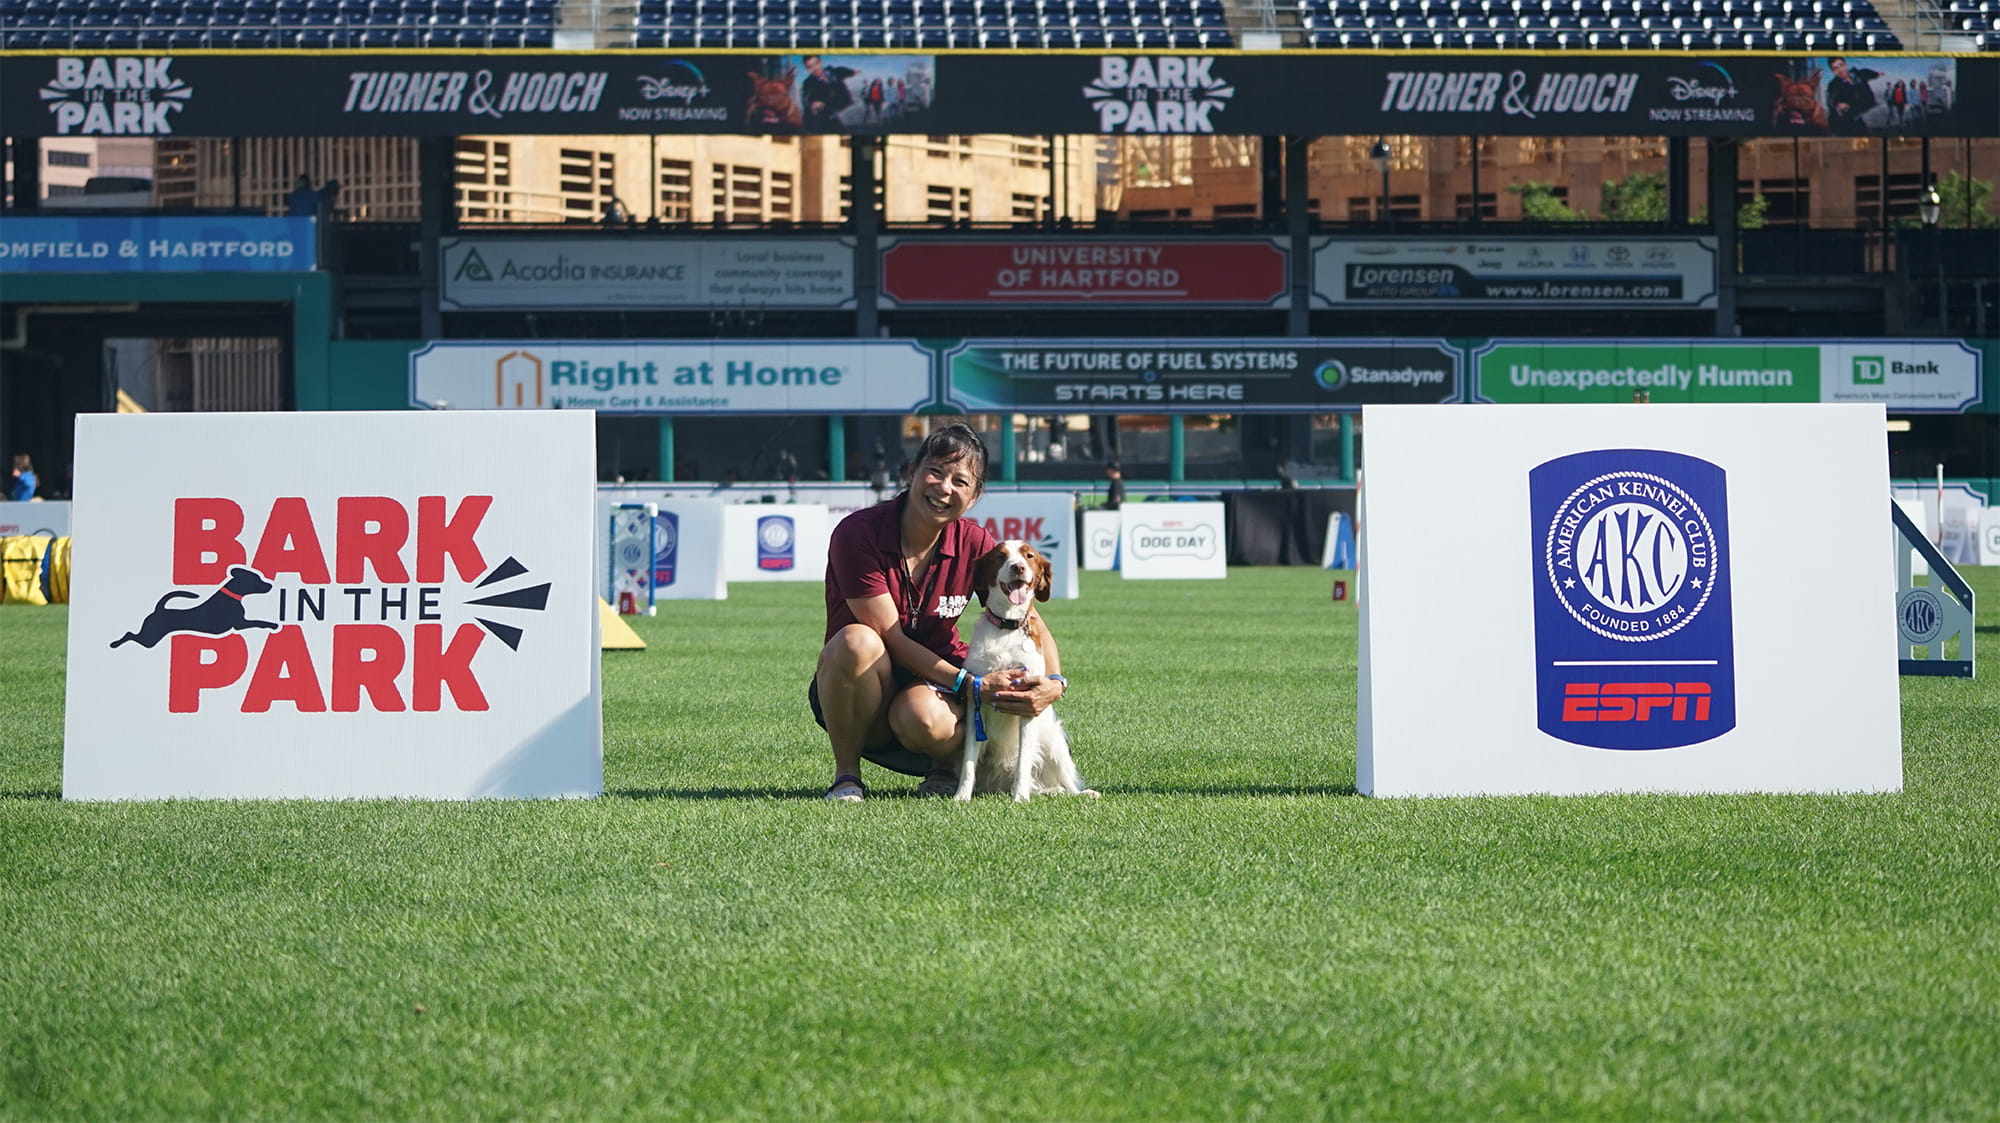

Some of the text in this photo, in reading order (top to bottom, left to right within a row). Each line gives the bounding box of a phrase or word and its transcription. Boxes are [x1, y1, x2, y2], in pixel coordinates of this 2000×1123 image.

[57, 57, 173, 89] BARK
[1101, 56, 1214, 88] BARK
[84, 90, 151, 100] IN THE
[344, 69, 608, 118] TURNER & HOOCH
[1127, 88, 1194, 100] IN THE
[1381, 70, 1638, 118] TURNER & HOOCH
[57, 101, 172, 134] PARK
[619, 108, 727, 120] NOW STREAMING
[1101, 101, 1214, 133] PARK
[1650, 109, 1754, 121] NOW STREAMING
[118, 240, 138, 257] &
[150, 240, 293, 258] HARTFORD
[737, 251, 824, 262] Local business
[1013, 247, 1162, 265] UNIVERSITY
[501, 255, 684, 280] Acadia INSURANCE
[714, 268, 842, 281] community coverage
[997, 269, 1179, 287] OF HARTFORD
[1353, 266, 1454, 288] Lorensen
[709, 283, 734, 295] that
[738, 284, 781, 297] always
[810, 284, 843, 295] home
[1367, 287, 1438, 297] AUTO GROUP
[1486, 283, 1669, 298] www.lorensen.com
[1001, 352, 1297, 370] THE FUTURE OF FUEL SYSTEMS
[1855, 360, 1939, 380] TD Bank
[551, 360, 842, 391] Right at Home
[1350, 367, 1444, 385] Stanadyne
[1510, 364, 1793, 391] Unexpectedly Human
[568, 396, 604, 407] Home
[610, 396, 639, 407] Care
[658, 396, 728, 407] Assistance
[1055, 385, 1243, 400] STARTS HERE
[967, 517, 1045, 541] ARK
[1557, 481, 1706, 569] AMERICAN KENNEL CLUB
[172, 495, 494, 585] BARK
[1140, 536, 1208, 548] DOG DAY
[1584, 507, 1680, 610] AKC
[279, 588, 442, 621] IN THE
[1581, 602, 1686, 632] FOUNDED 1884
[1907, 602, 1933, 633] AKC
[168, 623, 490, 713] PARK
[1562, 682, 1712, 722] ESPN
